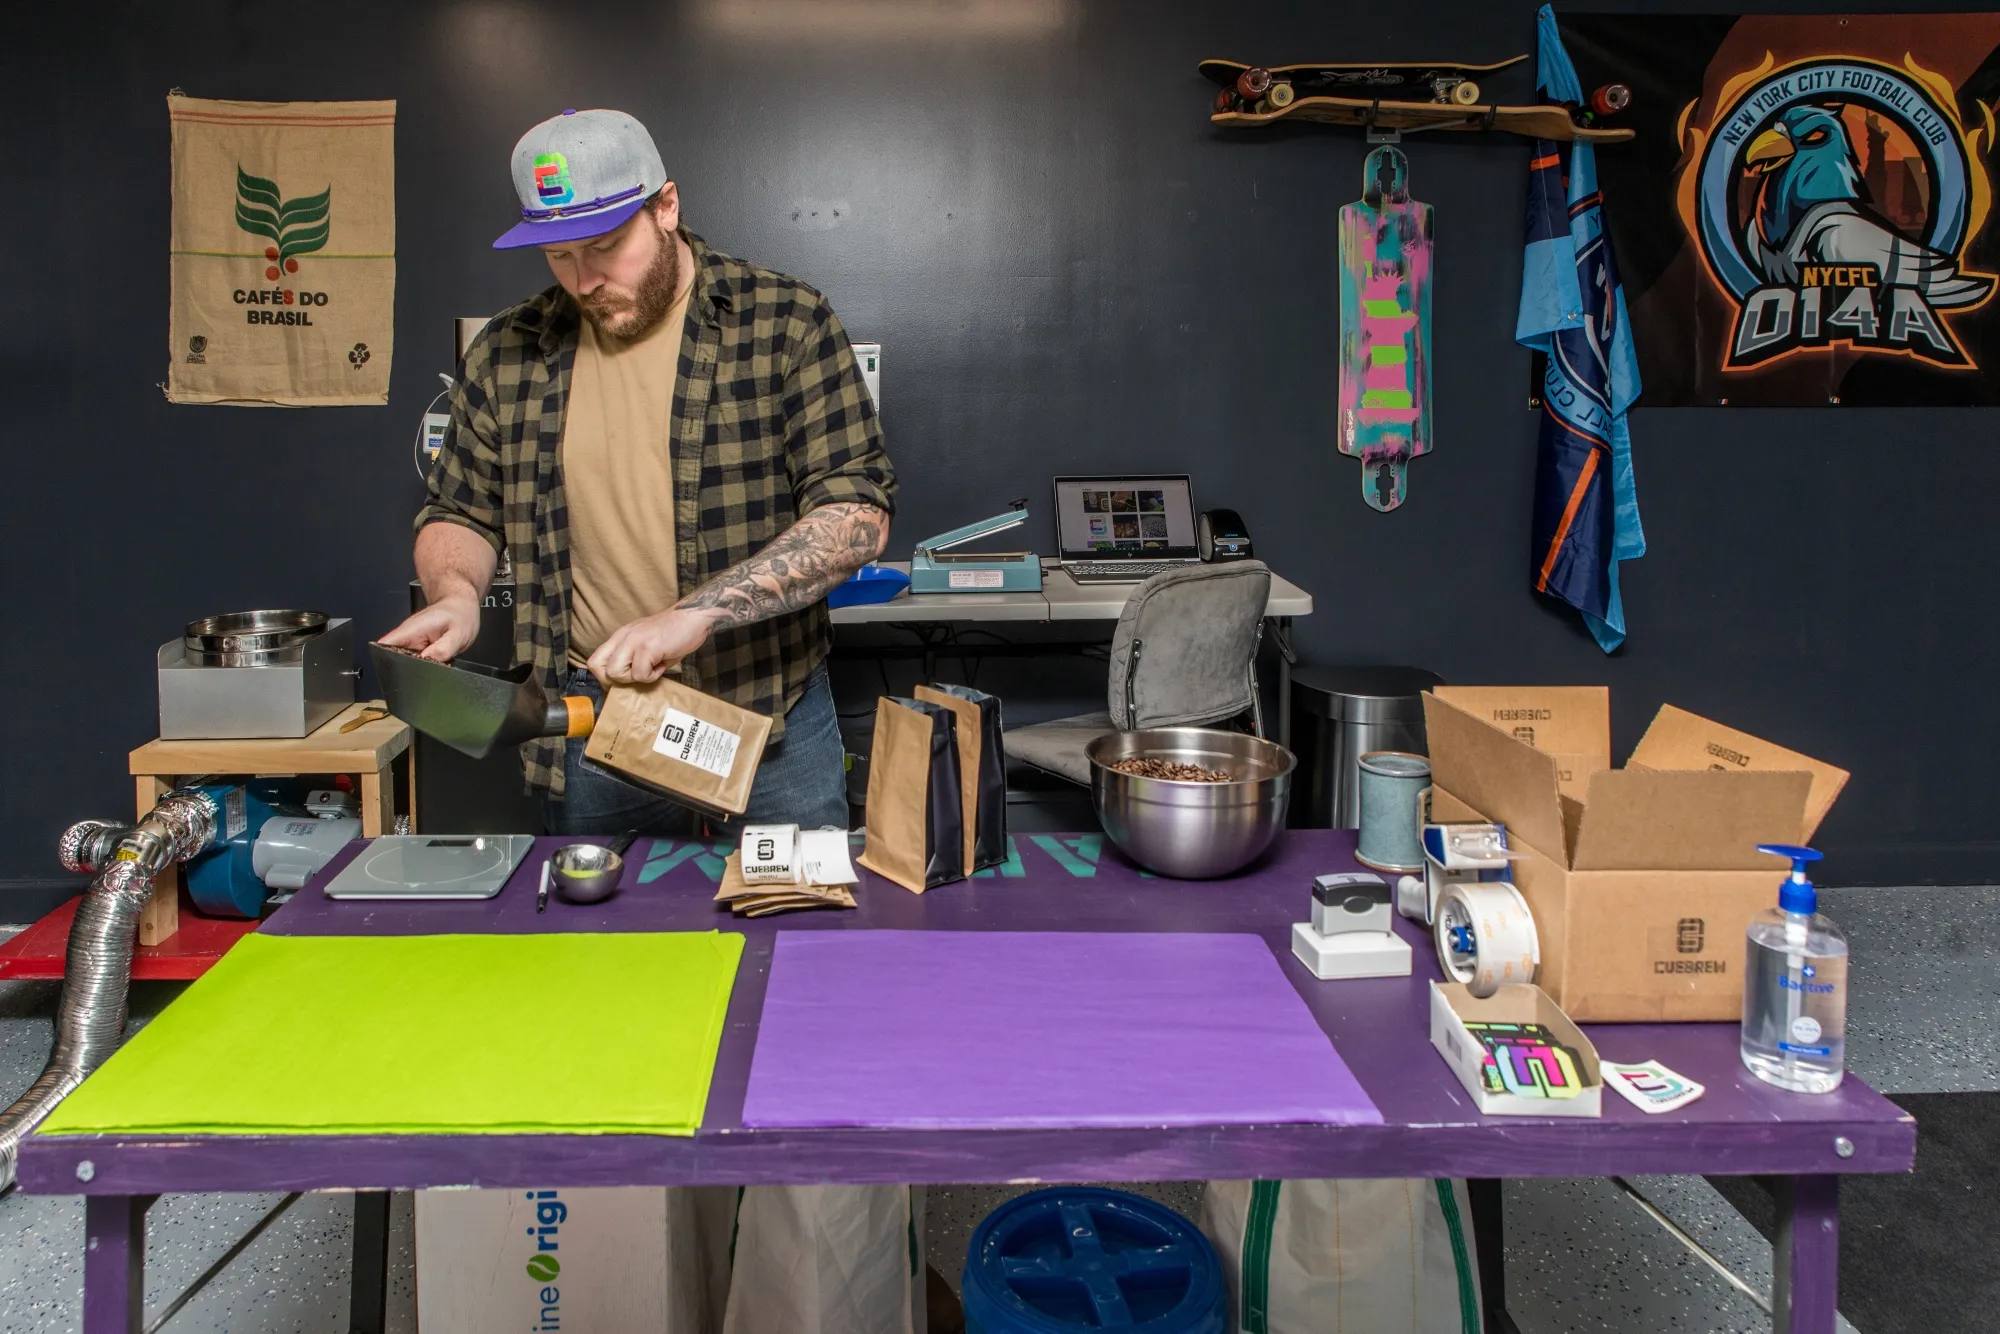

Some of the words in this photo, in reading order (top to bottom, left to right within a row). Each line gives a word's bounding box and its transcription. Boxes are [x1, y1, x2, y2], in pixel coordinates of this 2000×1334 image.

[1723, 113, 1756, 146] NEW
[1752, 83, 1794, 113] YORK
[1797, 70, 1836, 92] CITY
[1841, 71, 1914, 113] FOOTBALL
[1912, 107, 1948, 146] CLUB
[1802, 267, 1878, 287] NYCFC
[233, 286, 294, 305] CAFÉS
[299, 292, 329, 306] DO
[247, 310, 313, 326] BRASIL
[501, 591, 513, 607] 3
[1494, 709, 1551, 721] CUEBREW
[680, 719, 701, 760] CUEBREW
[745, 865, 789, 874] CUEBREW
[1654, 960, 1727, 974] CUEBREW
[532, 1286, 560, 1331] ine
